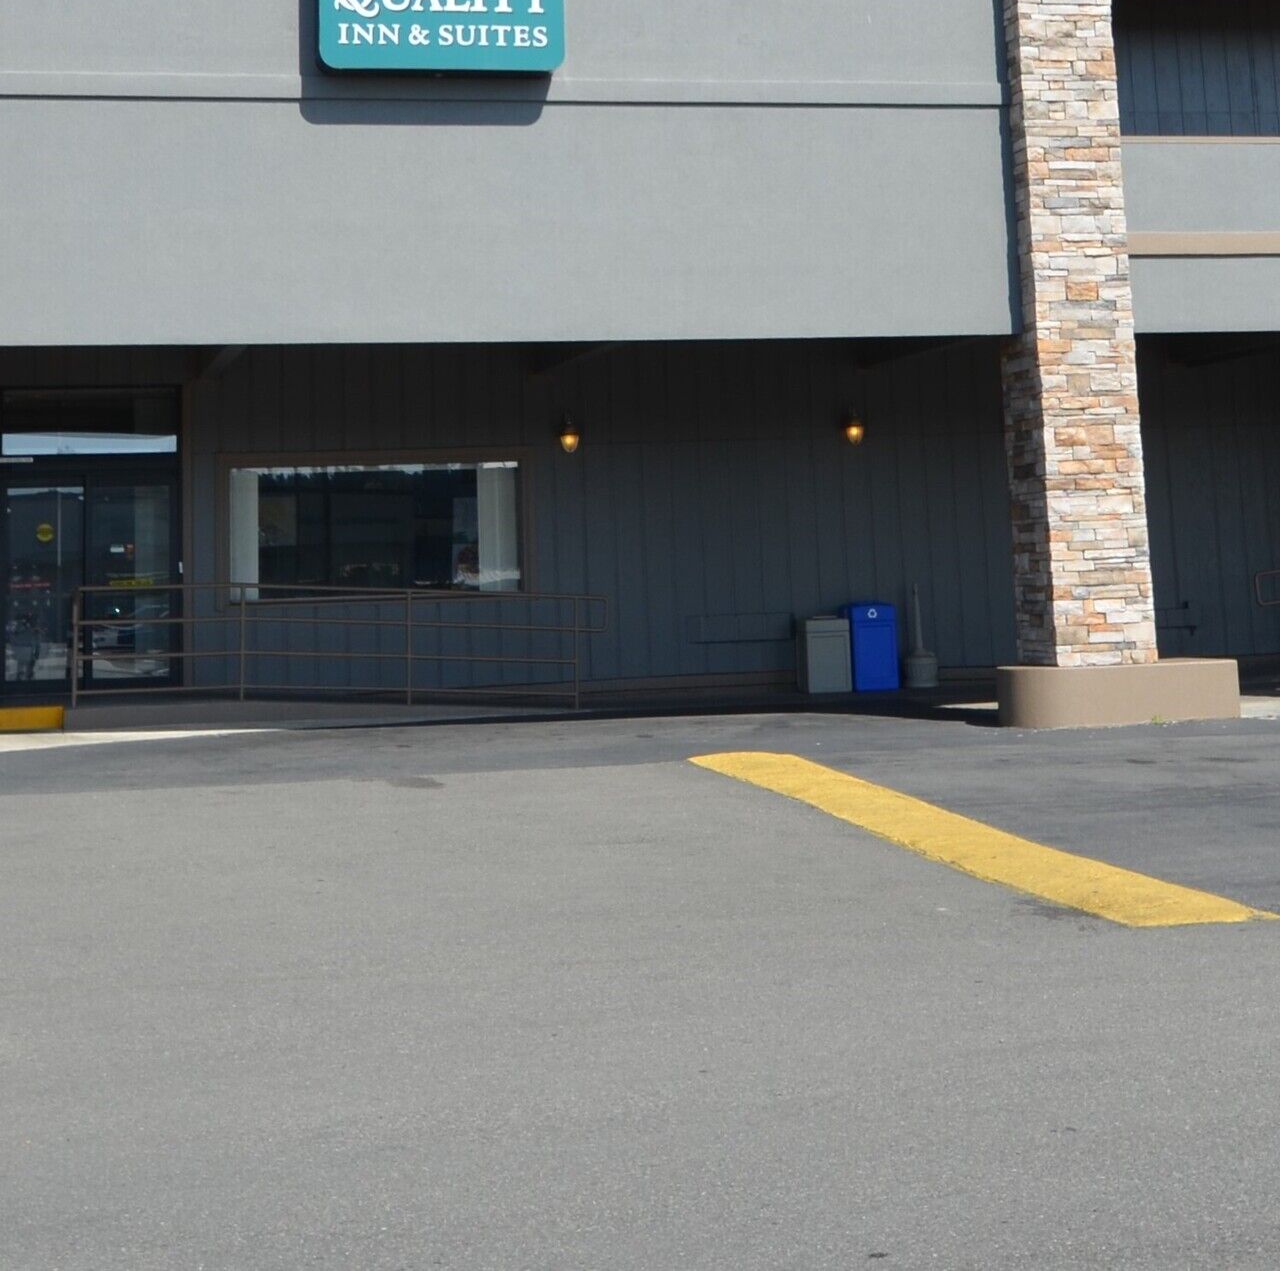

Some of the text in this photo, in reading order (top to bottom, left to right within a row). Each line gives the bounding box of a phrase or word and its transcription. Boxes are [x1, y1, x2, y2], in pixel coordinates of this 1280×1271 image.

[338, 23, 548, 47] INN & SUITES
